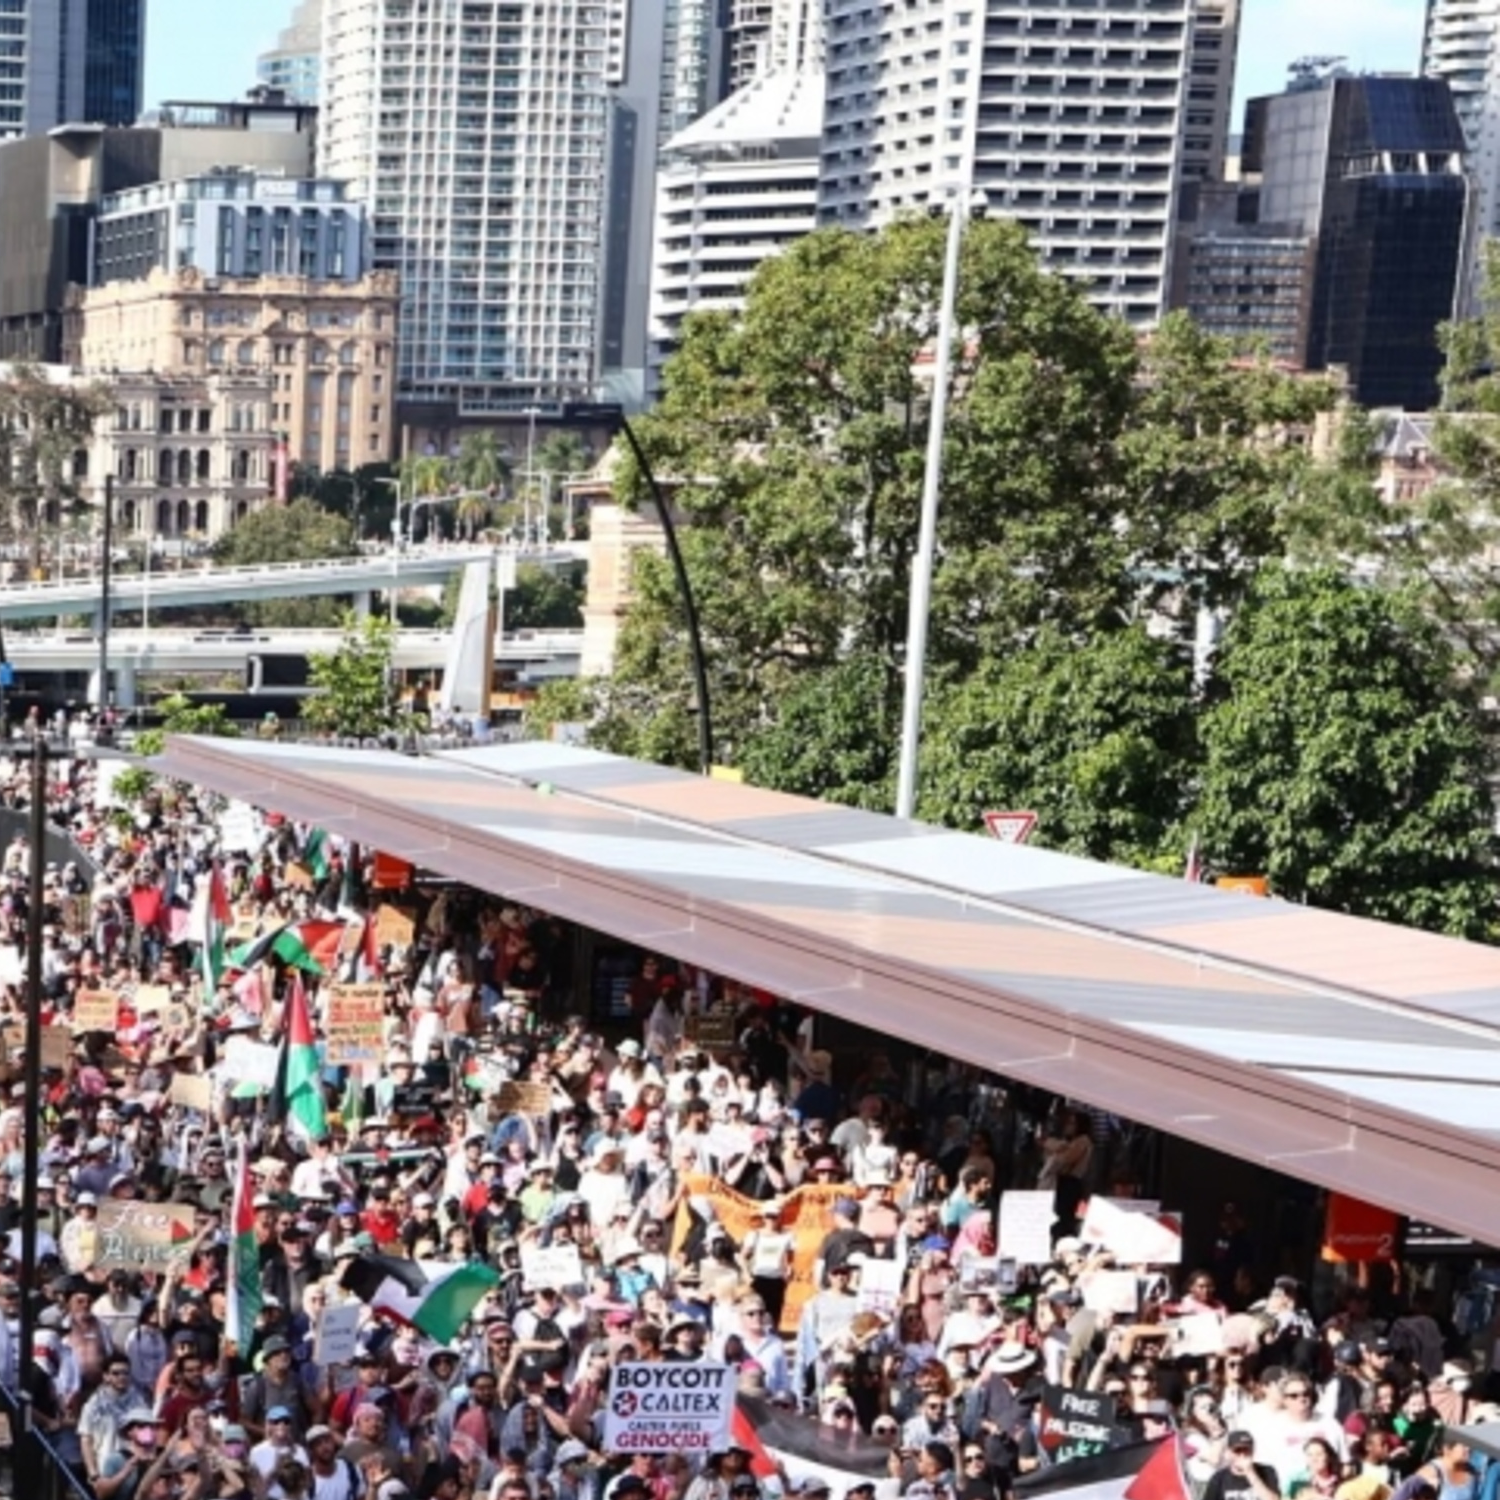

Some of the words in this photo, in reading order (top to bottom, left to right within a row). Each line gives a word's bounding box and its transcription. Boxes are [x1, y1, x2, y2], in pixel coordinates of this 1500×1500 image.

[1377, 1232, 1393, 1257] 2
[616, 1367, 726, 1389] BOYCOTT
[640, 1392, 720, 1413] CALTEX
[1061, 1393, 1100, 1417] FREE
[615, 1431, 711, 1448] GENOCIDE
